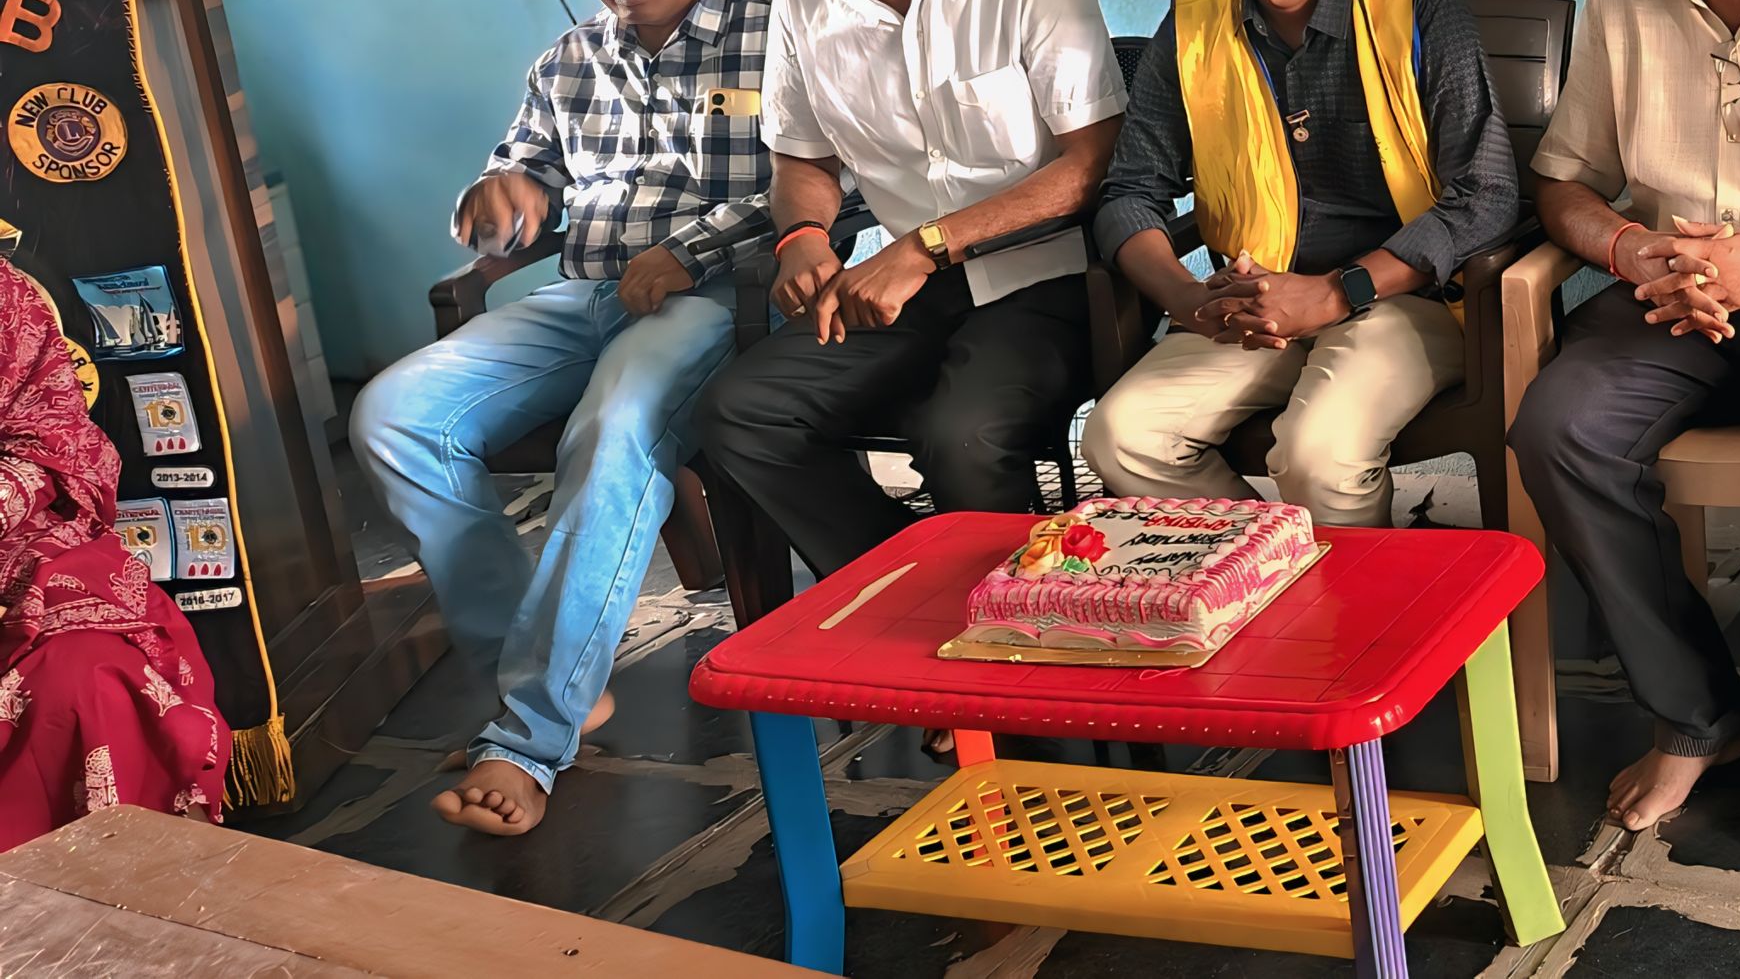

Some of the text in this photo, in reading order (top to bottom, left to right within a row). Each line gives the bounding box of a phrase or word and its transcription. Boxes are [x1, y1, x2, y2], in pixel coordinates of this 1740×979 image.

[14, 87, 108, 129] NEW CLUB
[32, 141, 121, 180] SPONSOR
